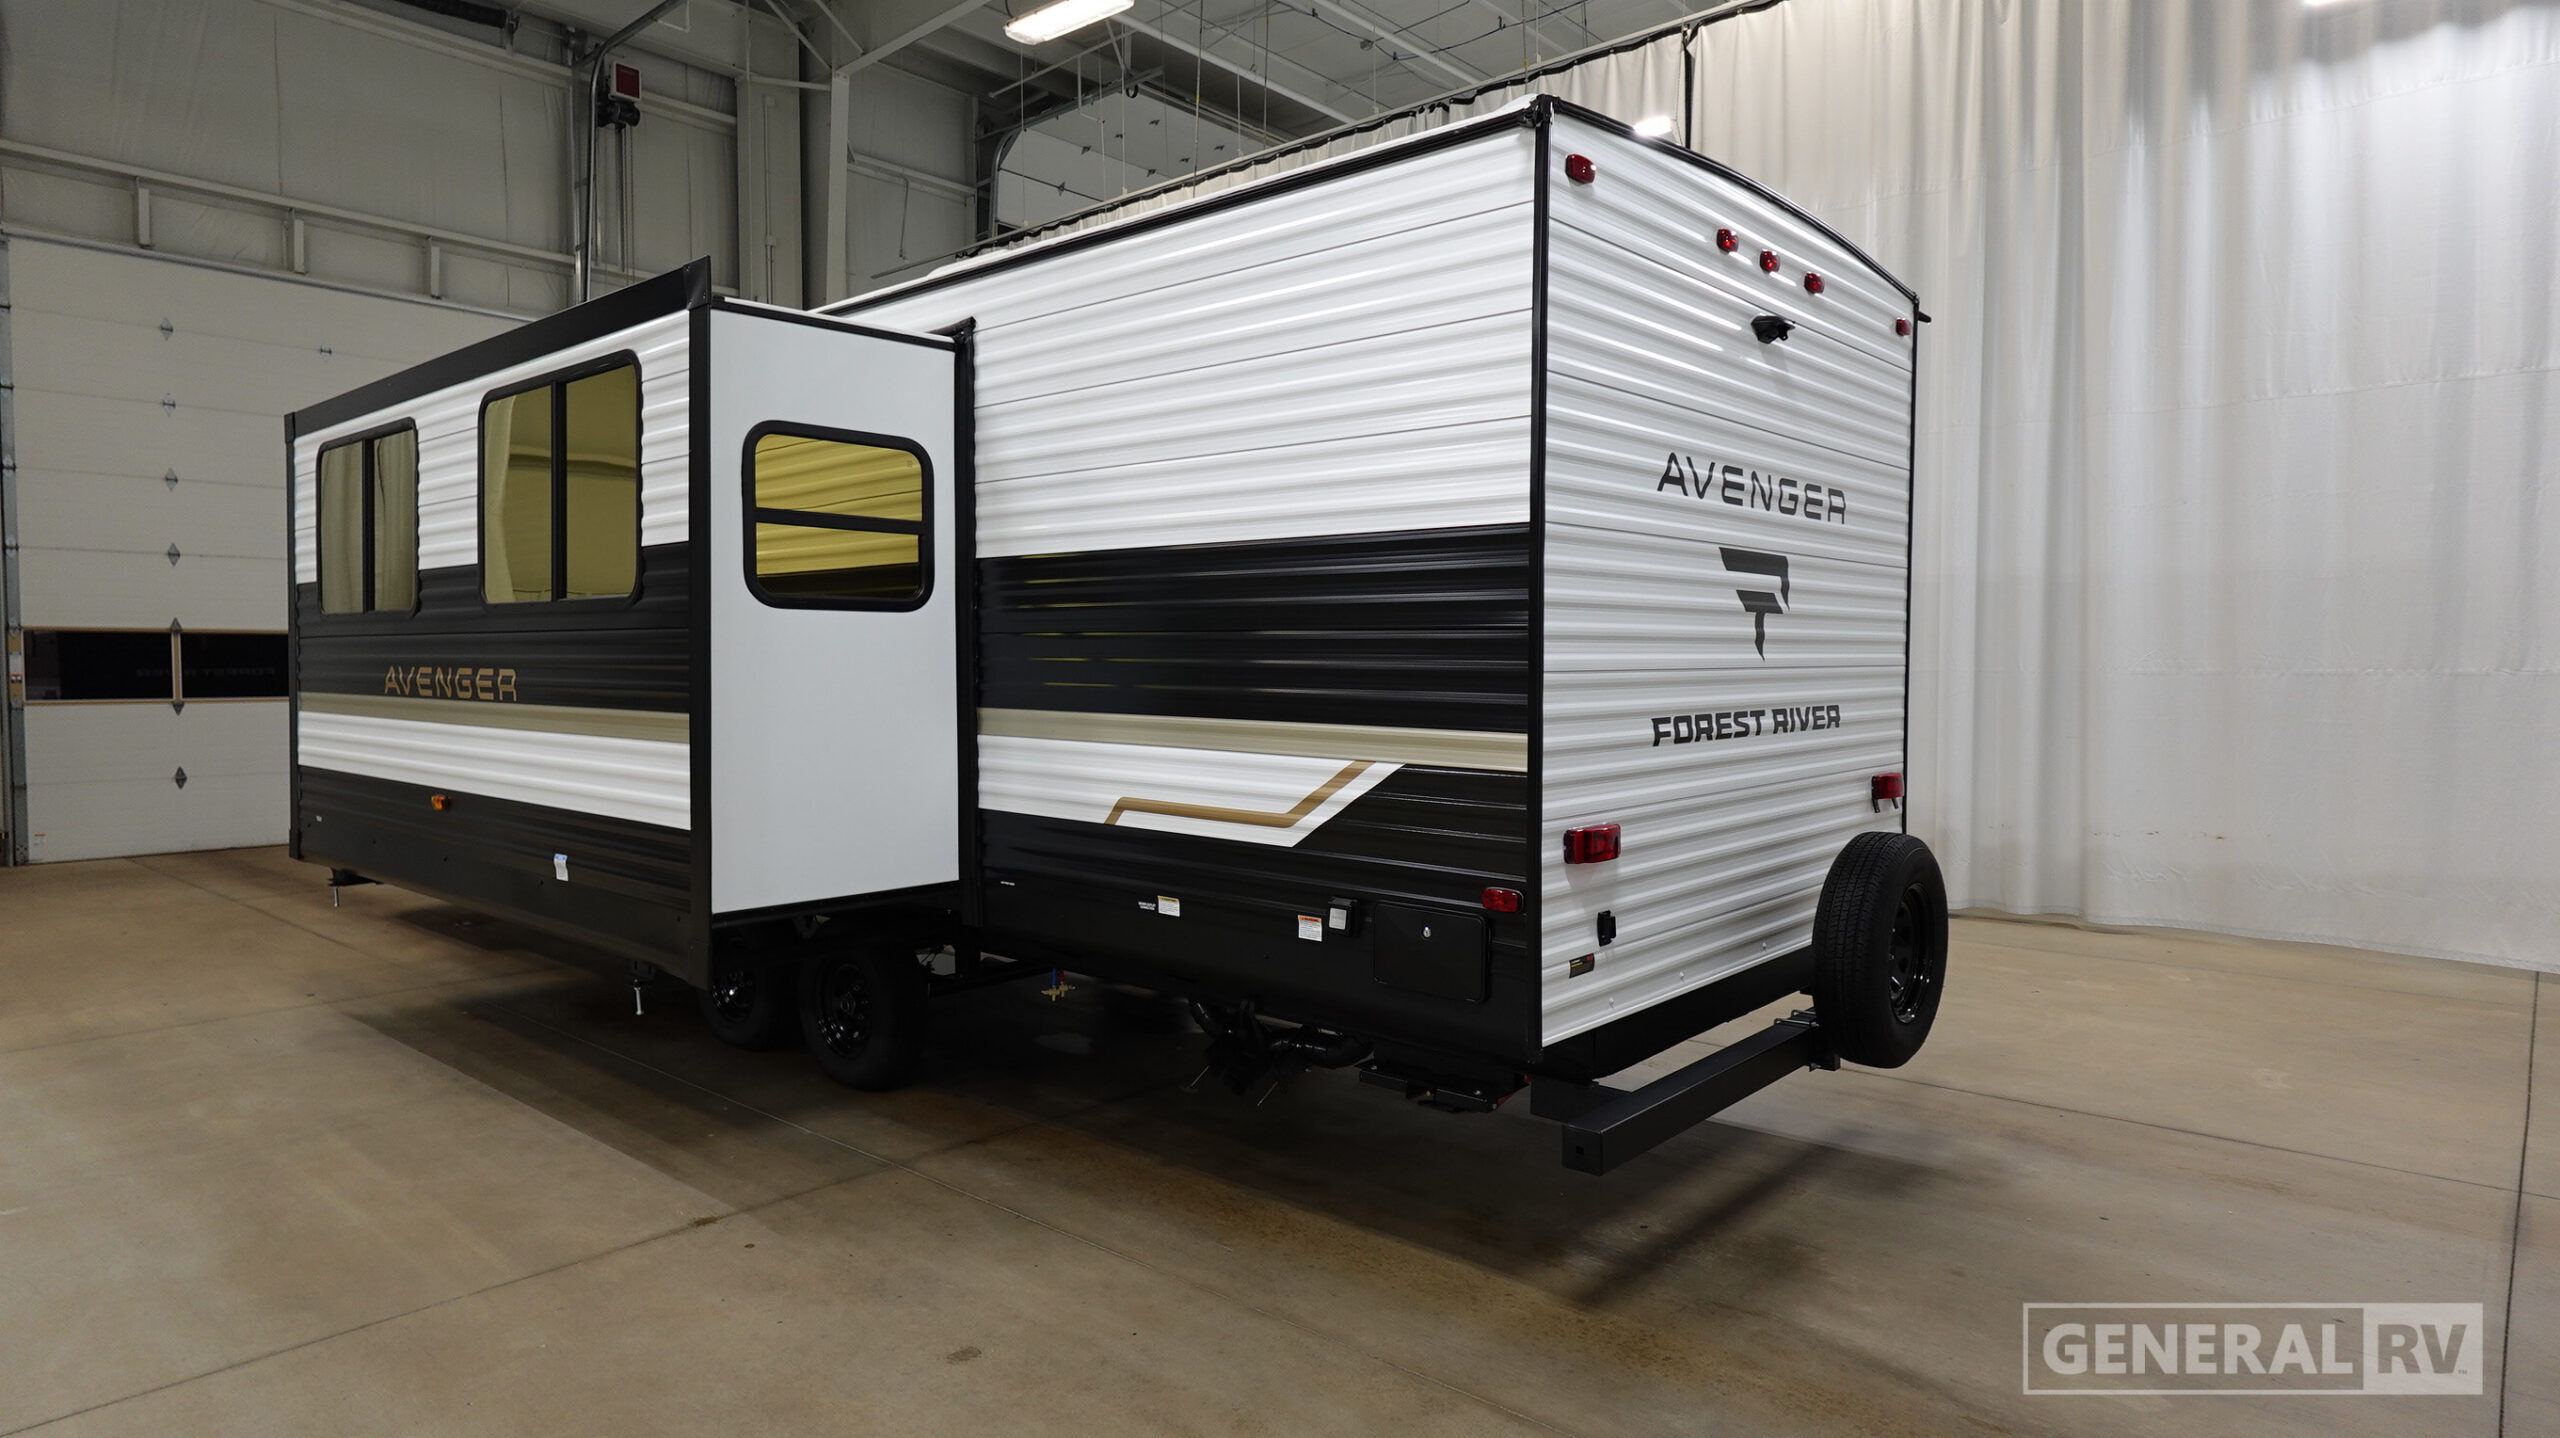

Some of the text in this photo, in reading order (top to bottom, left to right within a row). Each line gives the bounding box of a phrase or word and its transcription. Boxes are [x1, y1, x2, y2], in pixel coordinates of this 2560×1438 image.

[1657, 452, 1847, 525] AVENGER
[384, 665, 517, 702] AVENGER
[1651, 704, 1841, 747] FOREST RIVER
